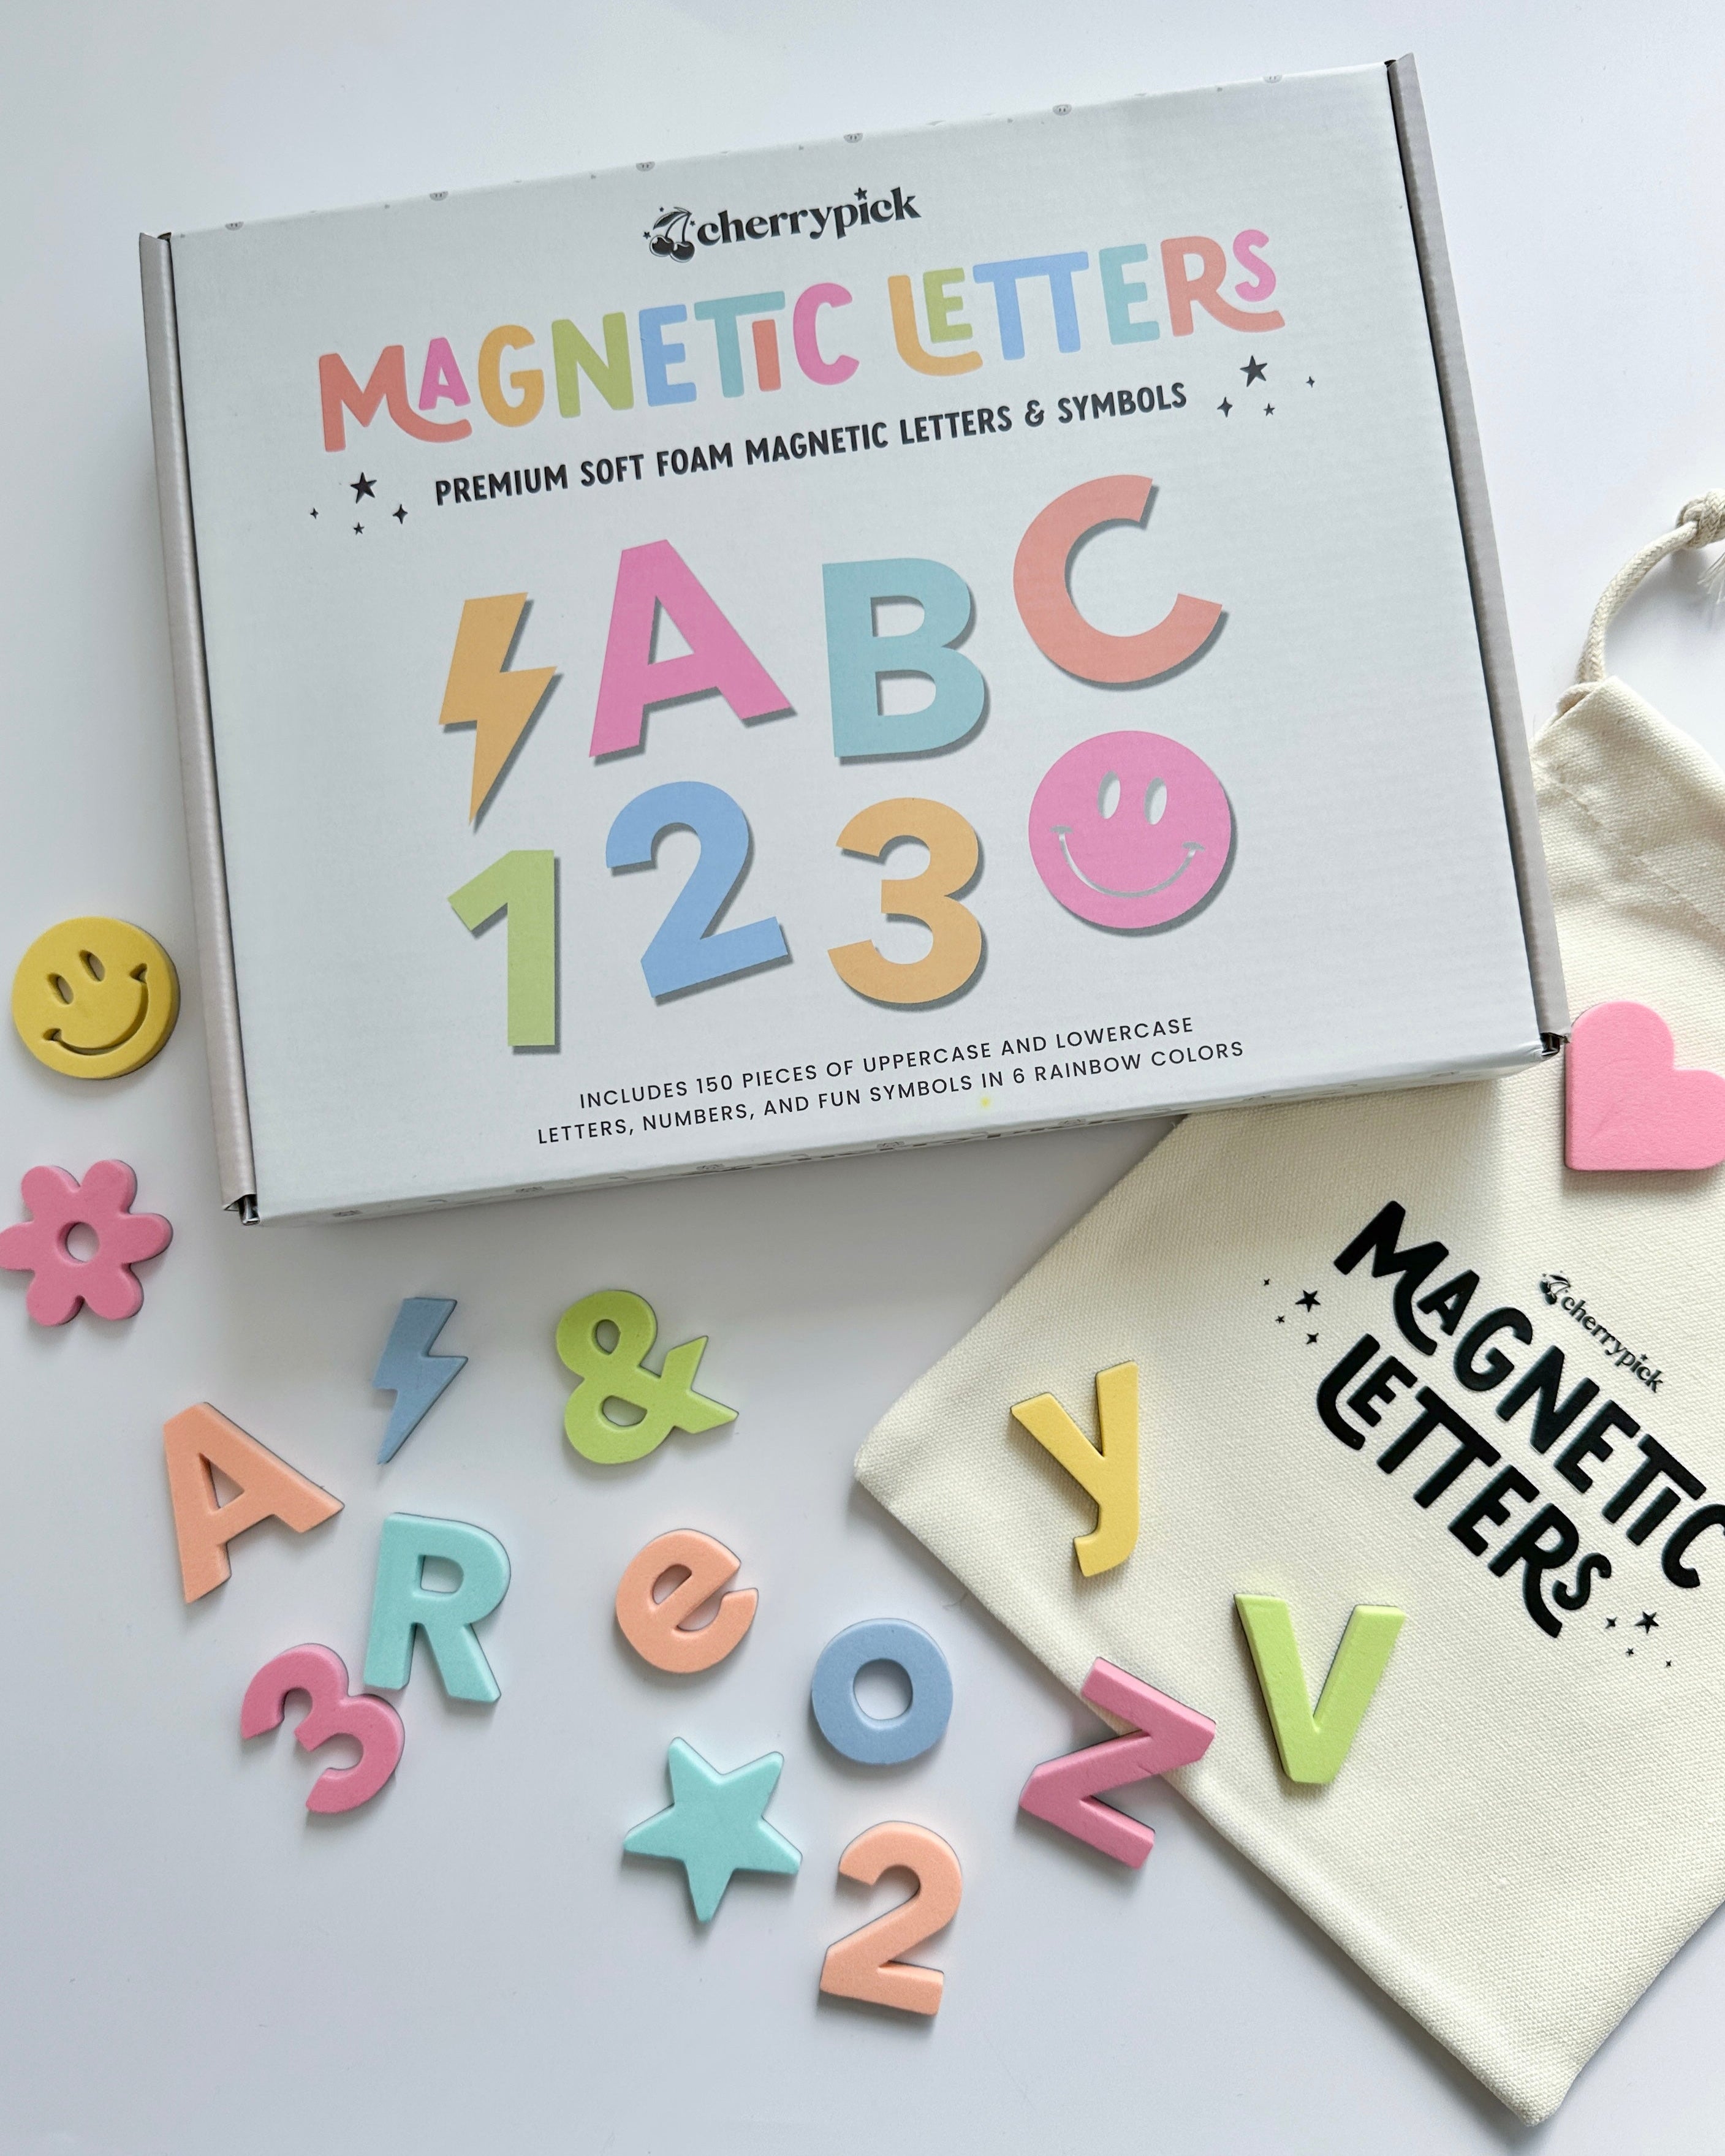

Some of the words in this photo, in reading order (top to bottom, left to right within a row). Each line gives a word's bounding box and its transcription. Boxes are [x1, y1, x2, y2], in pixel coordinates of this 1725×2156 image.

[697, 186, 921, 246] cherrypick
[319, 282, 860, 453] MAGNETIC
[888, 229, 1286, 377] LETTERS
[435, 460, 568, 506] PREMIUM
[580, 454, 644, 486] SOFT
[656, 442, 733, 477] FOAM
[745, 422, 889, 465] MAGNETIC
[900, 406, 1012, 445] LETTERS
[1025, 399, 1045, 427] &
[1058, 382, 1186, 423] SYMBOLS
[538, 1119, 634, 1144] LETTERS,
[643, 1103, 754, 1131] NUMBERS,
[764, 1095, 809, 1116] AND
[818, 1089, 860, 1109] FUN
[870, 1075, 972, 1102] SYMBOLS
[982, 1071, 1003, 1088] IN
[1013, 1068, 1025, 1084] 6
[1034, 1054, 1140, 1081] RAINBOW
[1151, 1042, 1243, 1066] COLORS
[580, 1081, 687, 1109] INCLUDES
[696, 1075, 732, 1094] 150
[742, 1065, 817, 1088] PIECES
[826, 1060, 853, 1077] OF
[863, 1043, 991, 1073] UPPERCASE
[1001, 1032, 1047, 1056] AND
[1056, 1017, 1192, 1049] LOWERCASE
[1561, 1295, 1663, 1394] cherrypick
[164, 1402, 344, 1603] A
[1317, 1333, 1612, 1638] LETTERS
[363, 1512, 511, 1703] R
[240, 1643, 405, 1813] 3
[820, 1820, 963, 2016] 2
